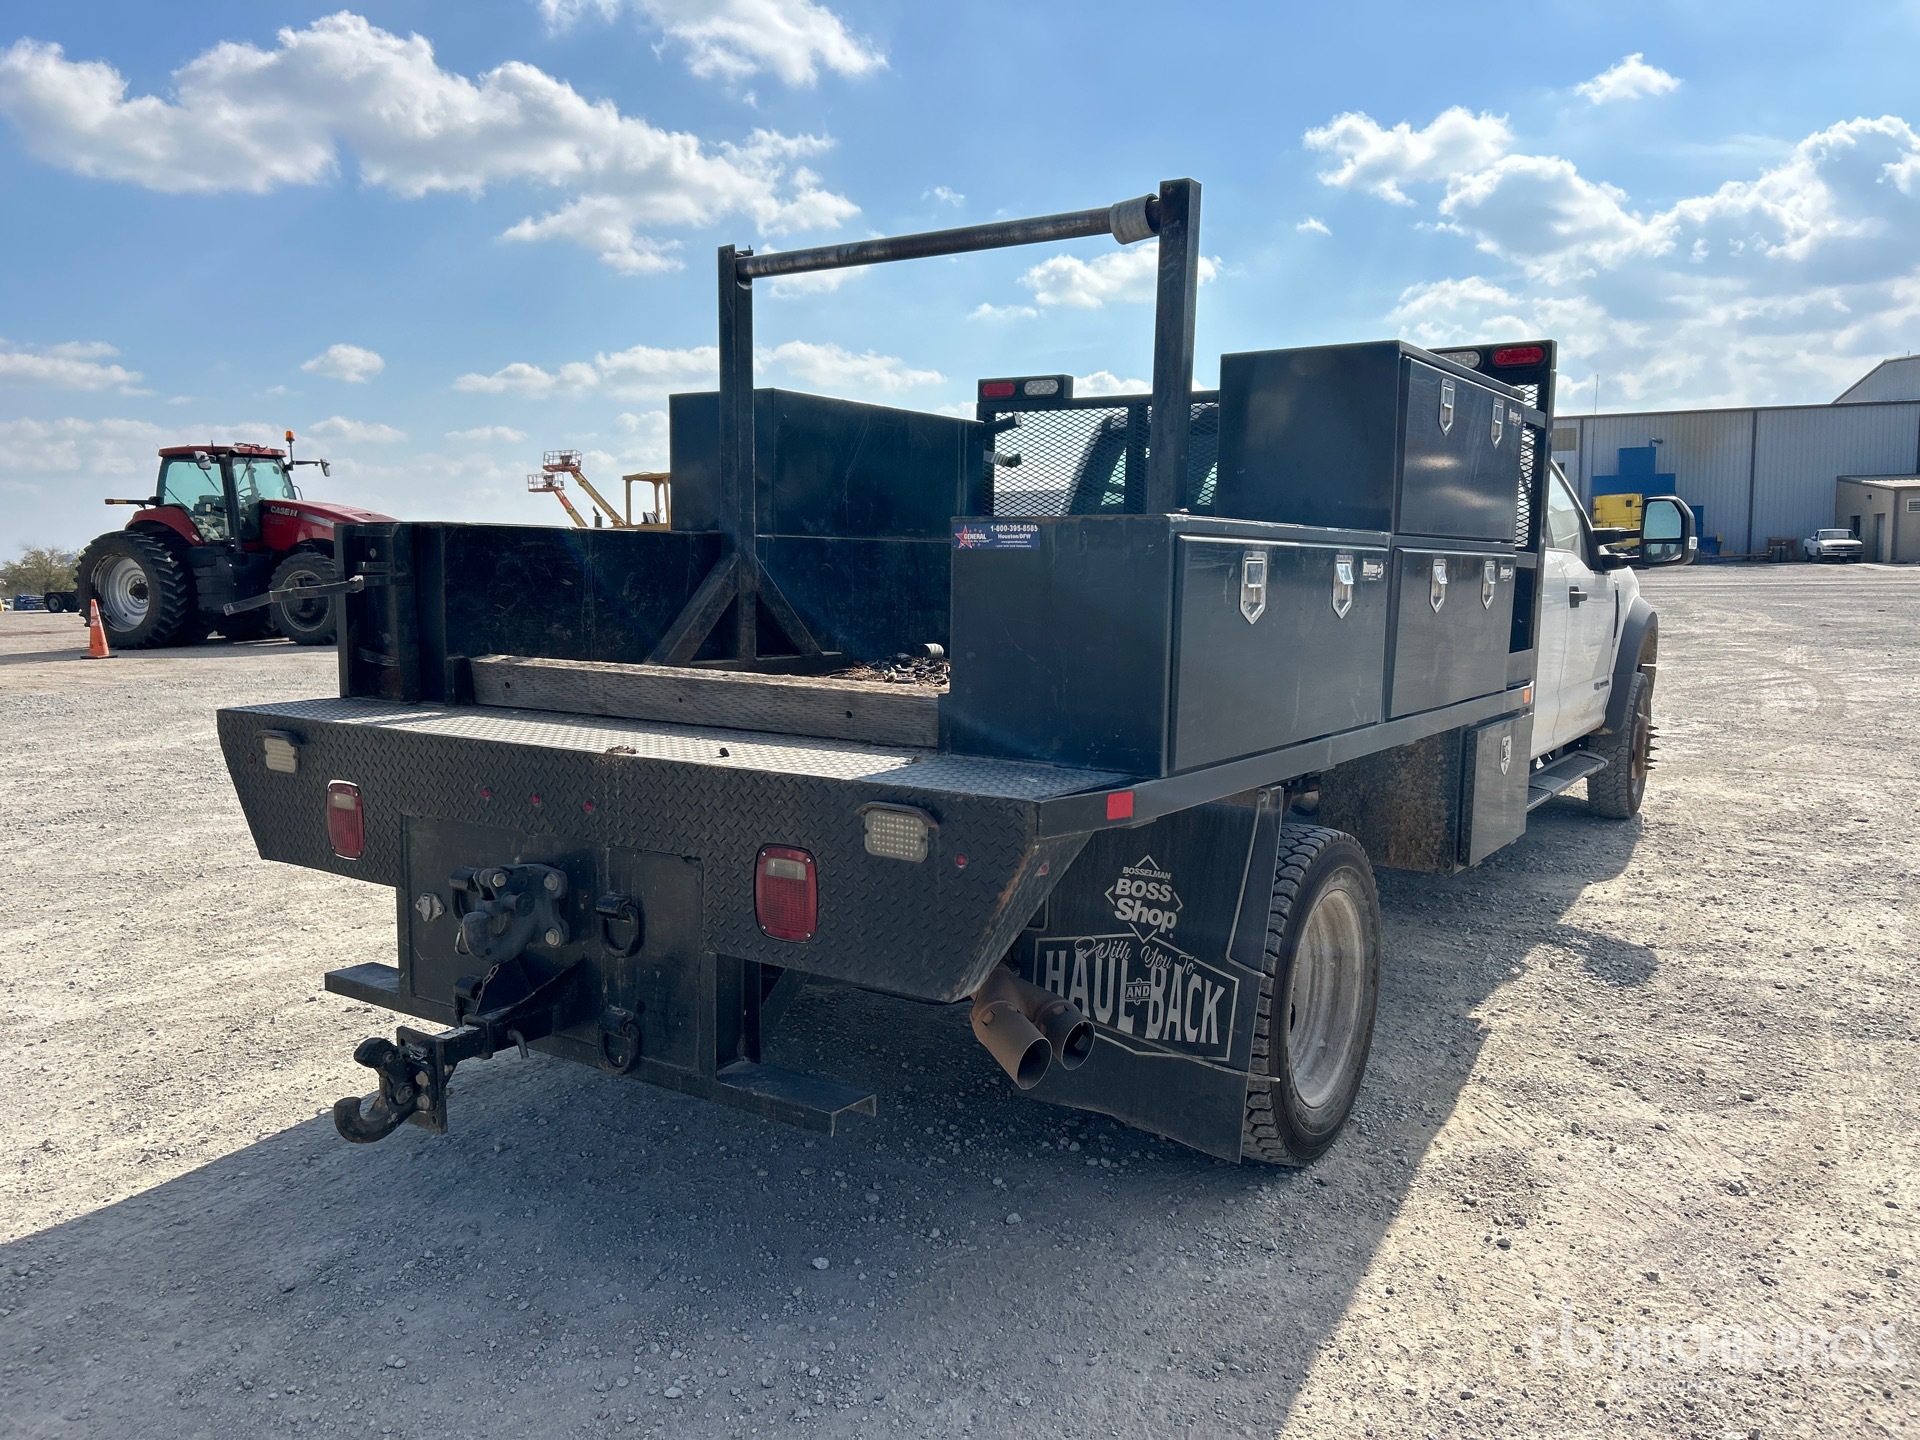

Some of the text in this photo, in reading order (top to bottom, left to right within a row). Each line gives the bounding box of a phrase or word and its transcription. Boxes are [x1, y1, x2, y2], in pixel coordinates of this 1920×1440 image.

[271, 505, 290, 516] CASE
[1122, 866, 1172, 880] BOSSELMAN
[1114, 877, 1173, 902] BOSS
[1114, 897, 1177, 933] Shop
[1074, 935, 1198, 976] With You To
[1044, 949, 1226, 1045] HAUL AND BACK
